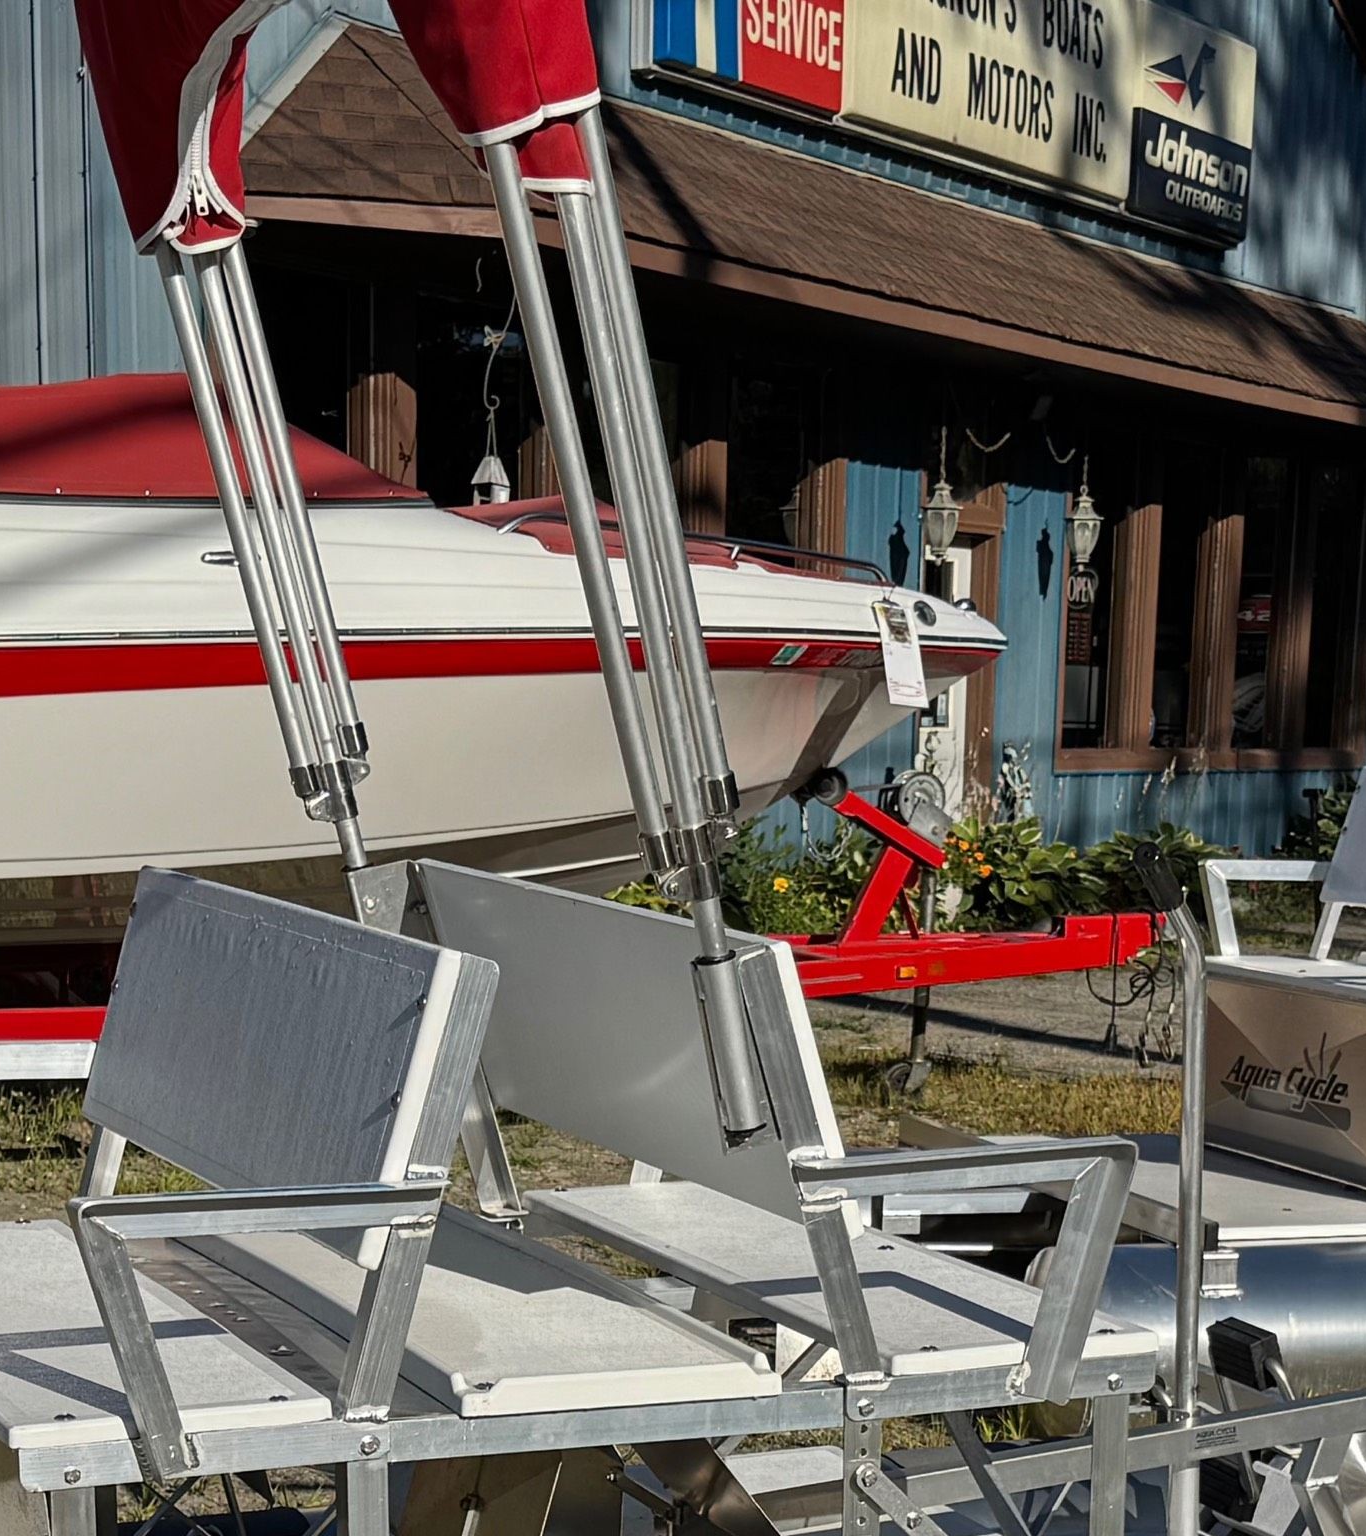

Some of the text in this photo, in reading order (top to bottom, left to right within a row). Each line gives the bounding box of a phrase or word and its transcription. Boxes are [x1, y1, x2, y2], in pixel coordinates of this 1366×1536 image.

[746, 0, 842, 72] SERVICE
[1043, 0, 1104, 69] BOATS
[891, 27, 1107, 163] AND MOTORS INC.
[1145, 122, 1248, 197] Johnson
[1165, 179, 1243, 222] OUTBOARDS
[1067, 576, 1095, 603] OPEN
[1225, 1055, 1349, 1111] Aqua Cycle
